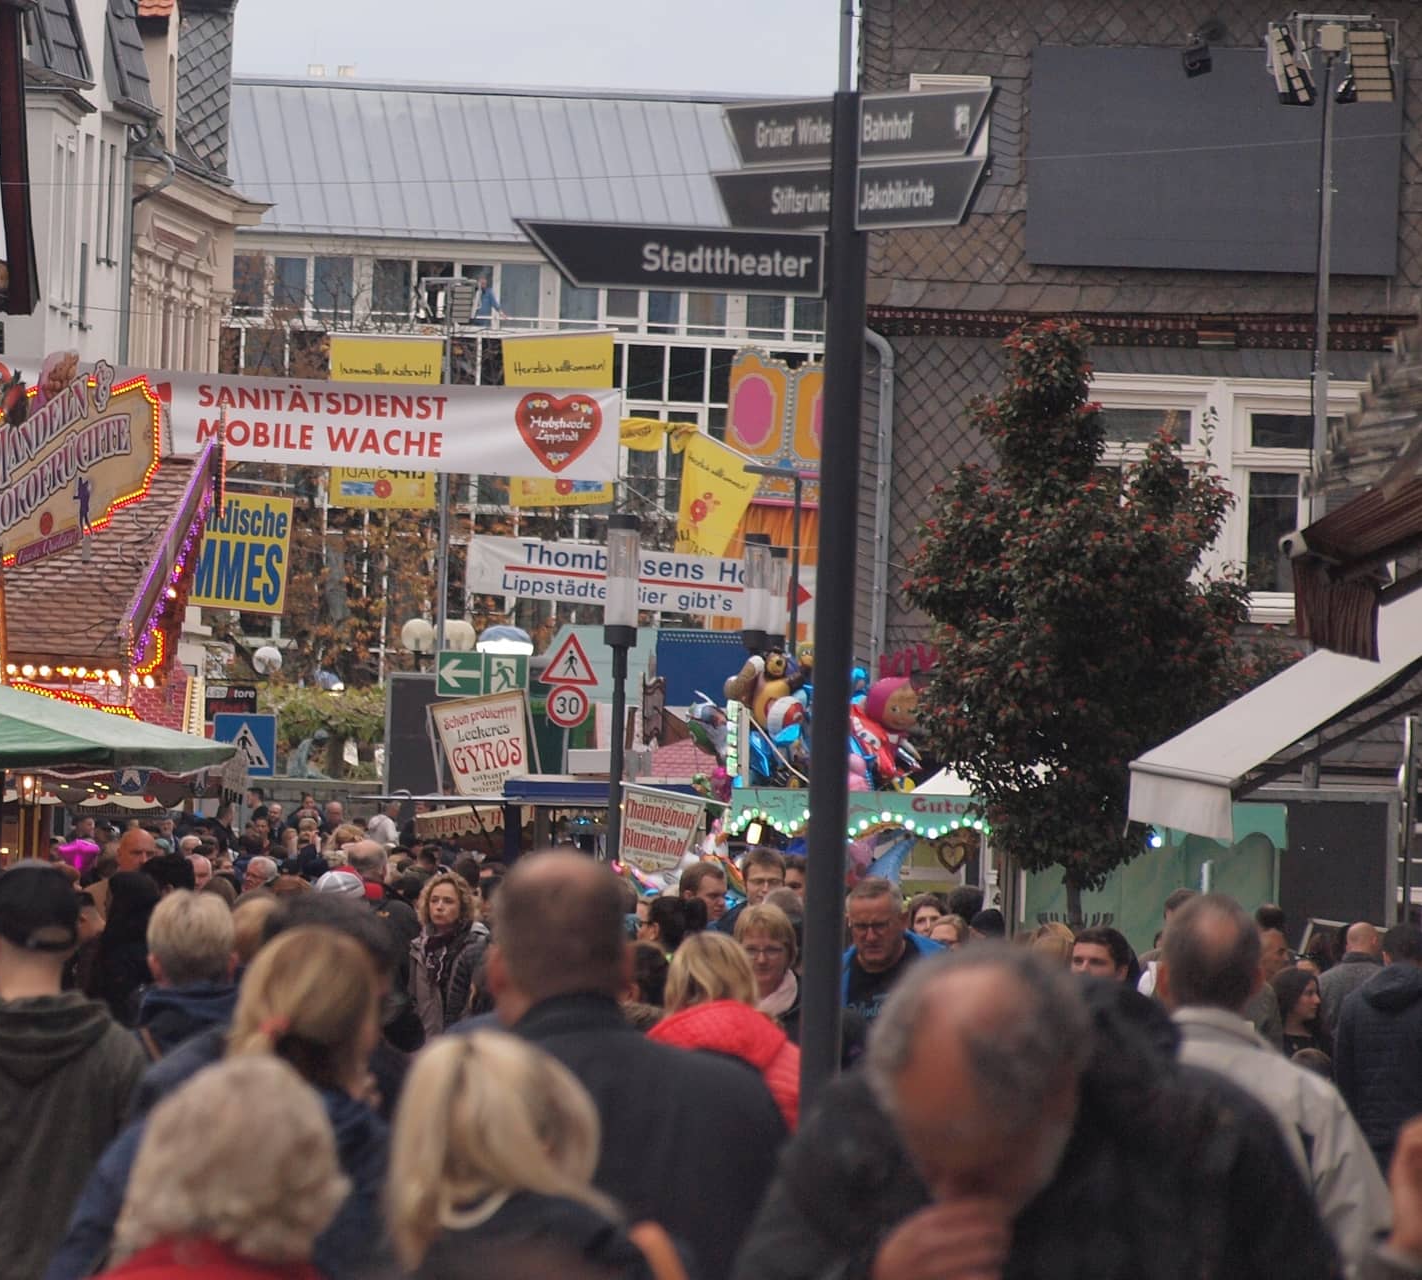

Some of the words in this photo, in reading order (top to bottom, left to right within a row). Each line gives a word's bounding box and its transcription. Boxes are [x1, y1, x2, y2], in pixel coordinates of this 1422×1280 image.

[755, 119, 795, 148] Grüner
[796, 118, 831, 145] Winke
[862, 112, 913, 142] Bahnhof
[860, 180, 934, 211] Jakobikirche
[641, 242, 814, 278] Stadttheater
[513, 361, 553, 376] Herzlich
[555, 358, 606, 374] willkommen!
[197, 383, 448, 421] SANITÄTSDIENST
[195, 417, 314, 450] MOBILE
[326, 426, 444, 458] WACHE
[529, 415, 592, 431] Herbstwoche
[535, 430, 579, 444] Lippstadt
[206, 499, 288, 539] ndische
[189, 538, 283, 606] MMES
[522, 543, 704, 581] Thombsens
[502, 573, 606, 599] Lippstädte
[639, 587, 667, 604] ier
[678, 591, 733, 611] gibt's
[556, 696, 580, 715] 30
[457, 724, 510, 742] Leckeres
[452, 737, 522, 774] GYROS
[625, 799, 697, 829] Champignons
[623, 828, 687, 857] Blumenkohl
